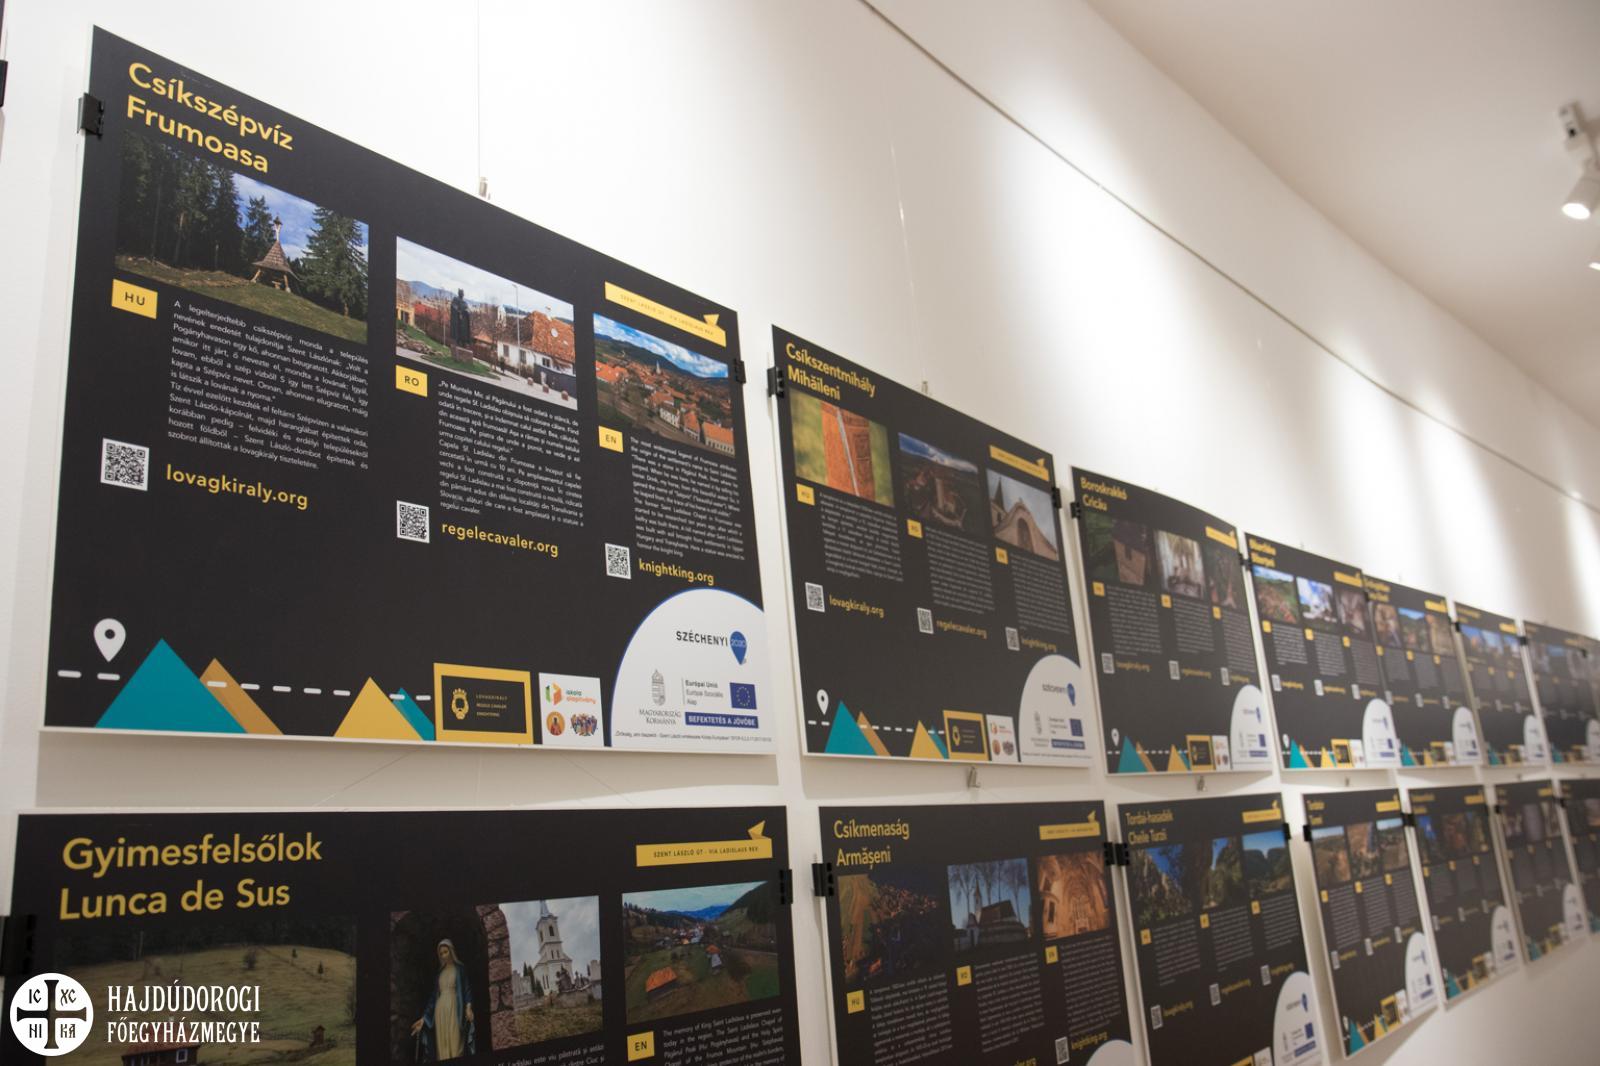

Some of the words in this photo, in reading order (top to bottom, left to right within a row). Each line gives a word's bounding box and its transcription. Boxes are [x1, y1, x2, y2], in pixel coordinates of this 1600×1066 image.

[129, 63, 293, 150] Csíkszépvíz
[127, 95, 268, 172] Frumoasa
[125, 292, 145, 306] HU
[404, 376, 419, 386] RO
[786, 343, 876, 397] Csíkszentmihály
[787, 365, 840, 400] Mihăileni
[605, 434, 616, 444] EN
[167, 464, 308, 509] lovagkiraly.org
[442, 522, 558, 557] regelecavaler.org
[639, 558, 714, 585] knightking.org
[676, 630, 728, 647] SZÉCHENYI
[689, 715, 726, 724] BEFEKTETÉS
[833, 818, 910, 840] Csíkmenaság
[62, 832, 322, 878] Gyimesfelsőlok
[836, 844, 891, 870] Armășeni
[59, 888, 167, 920] Lunca
[181, 880, 224, 912] de
[236, 878, 290, 908] Sus
[634, 1041, 647, 1051] EN
